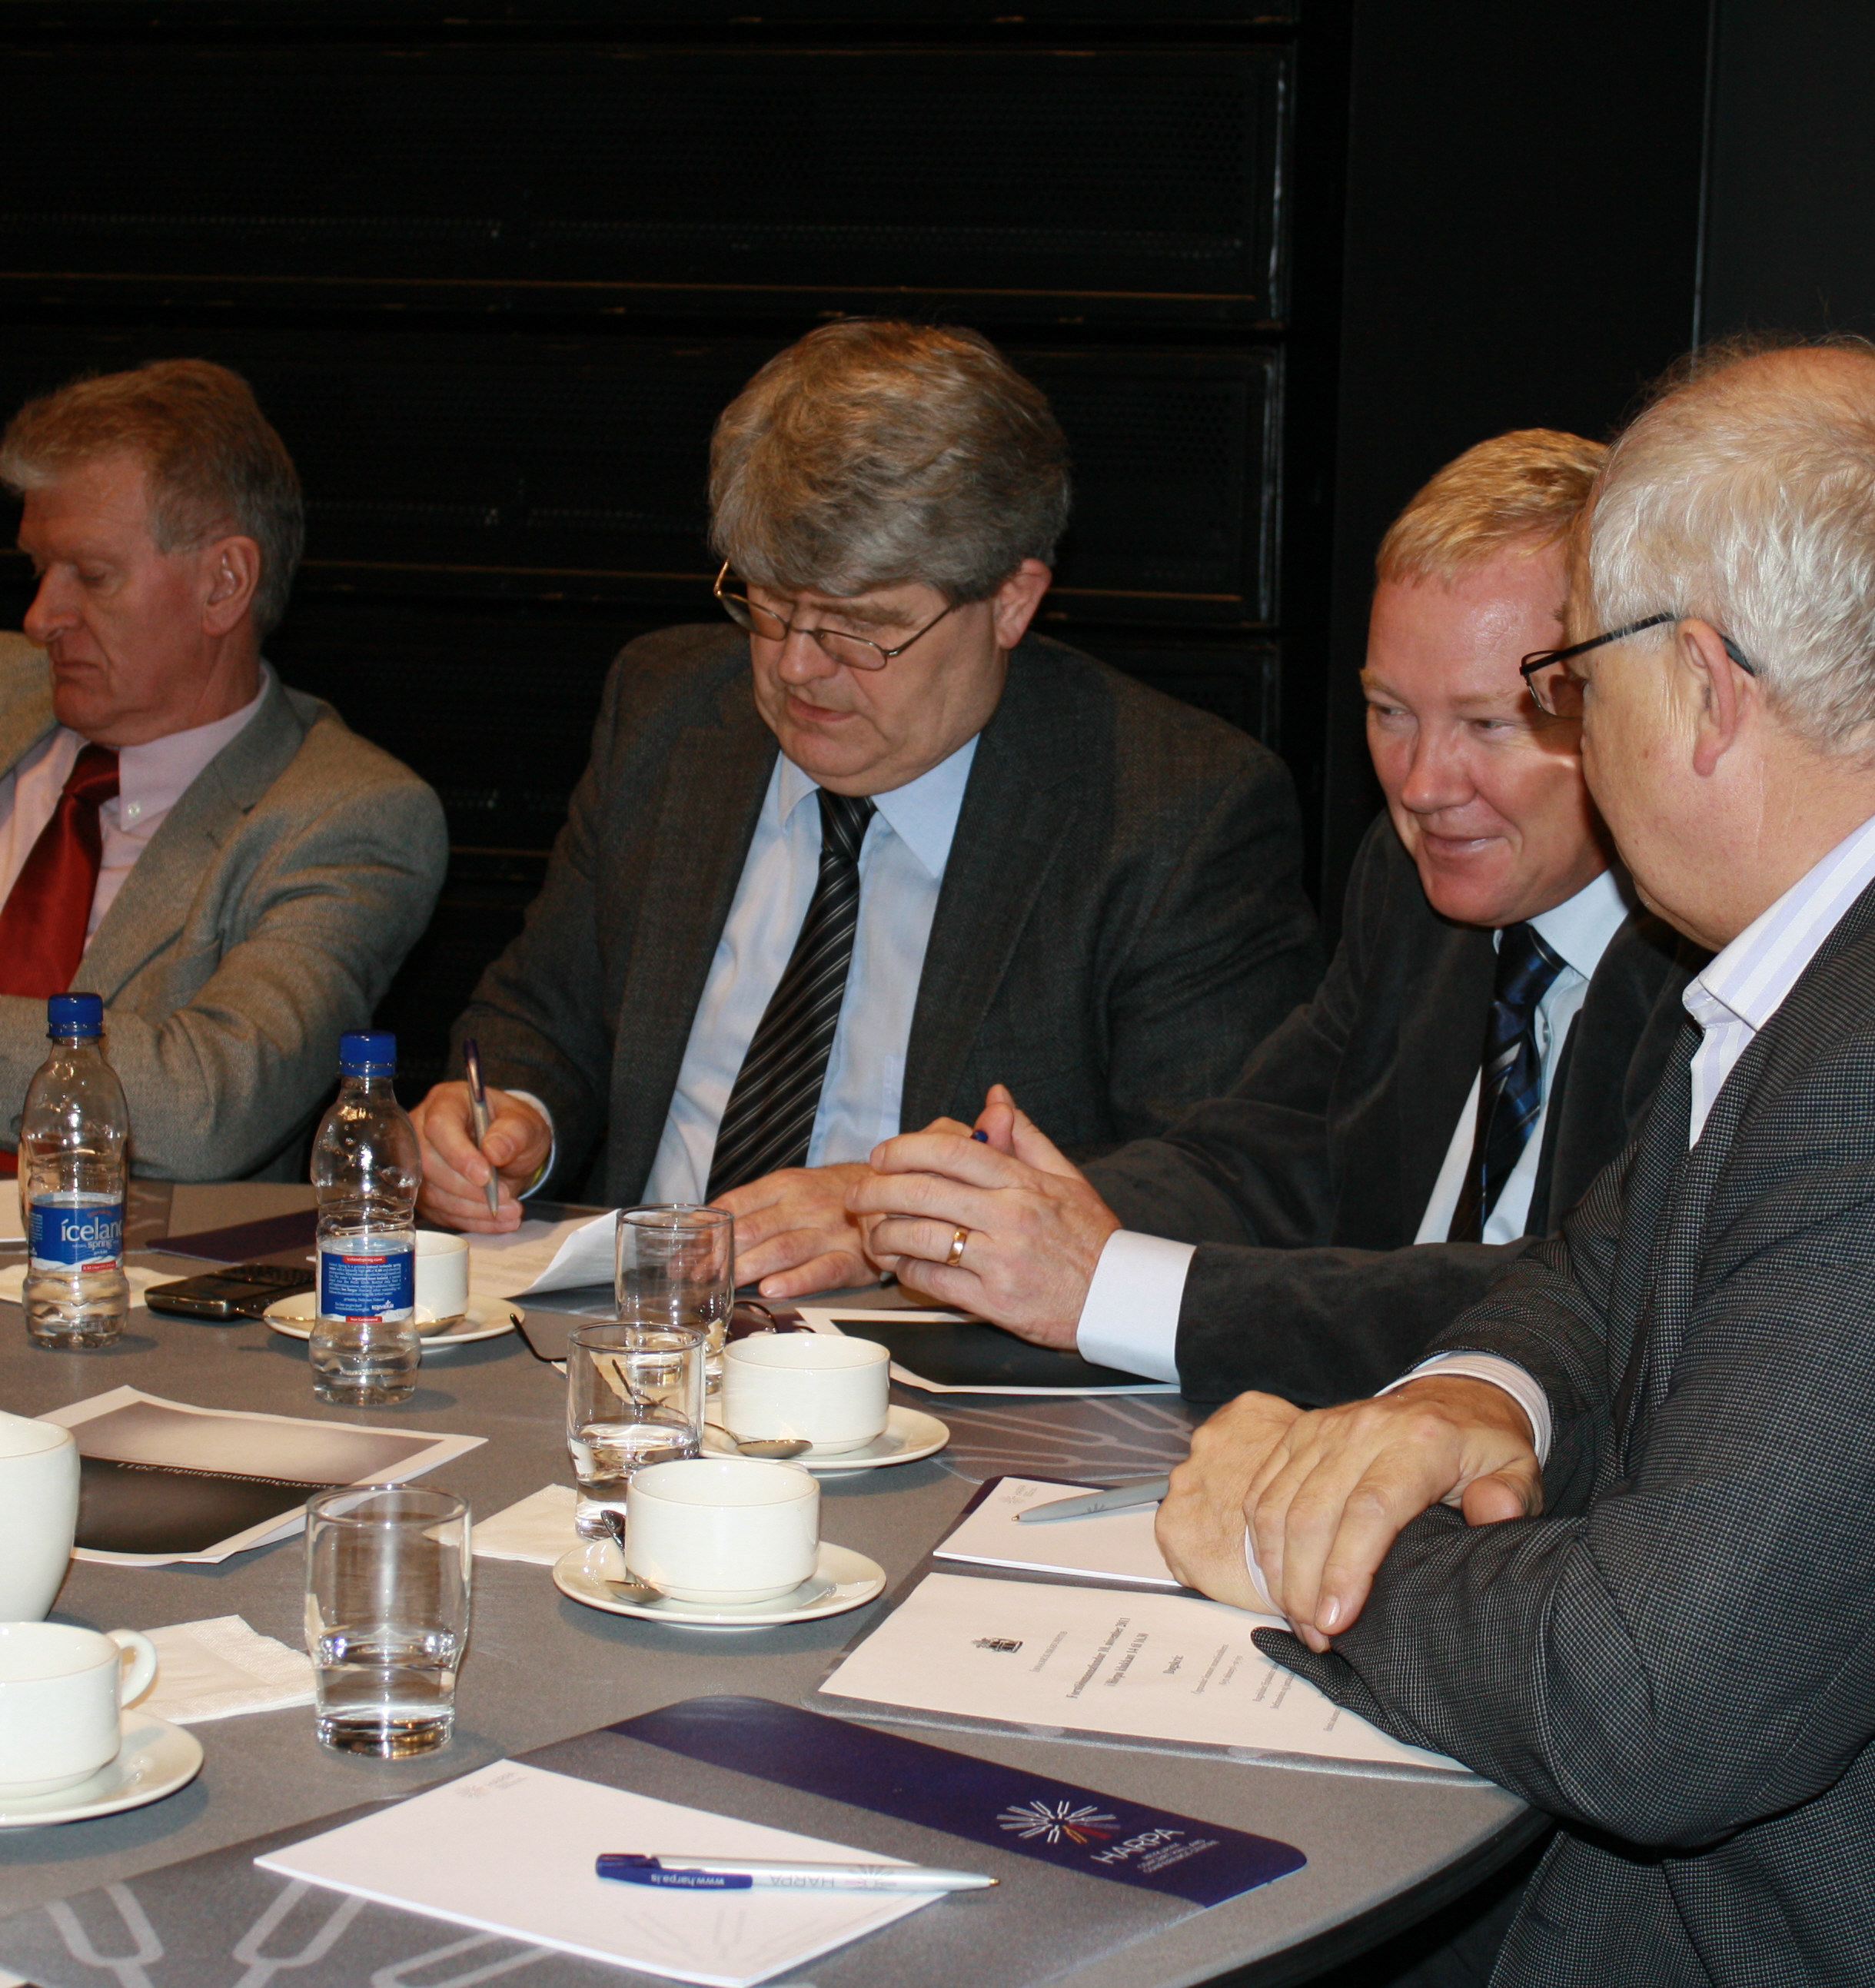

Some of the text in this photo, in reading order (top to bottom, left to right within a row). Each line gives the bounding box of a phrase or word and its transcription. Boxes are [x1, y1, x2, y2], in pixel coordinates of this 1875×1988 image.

[1090, 1828, 1185, 1864] HARPA
[650, 1873, 835, 1888] www.harpa.is HARPA
